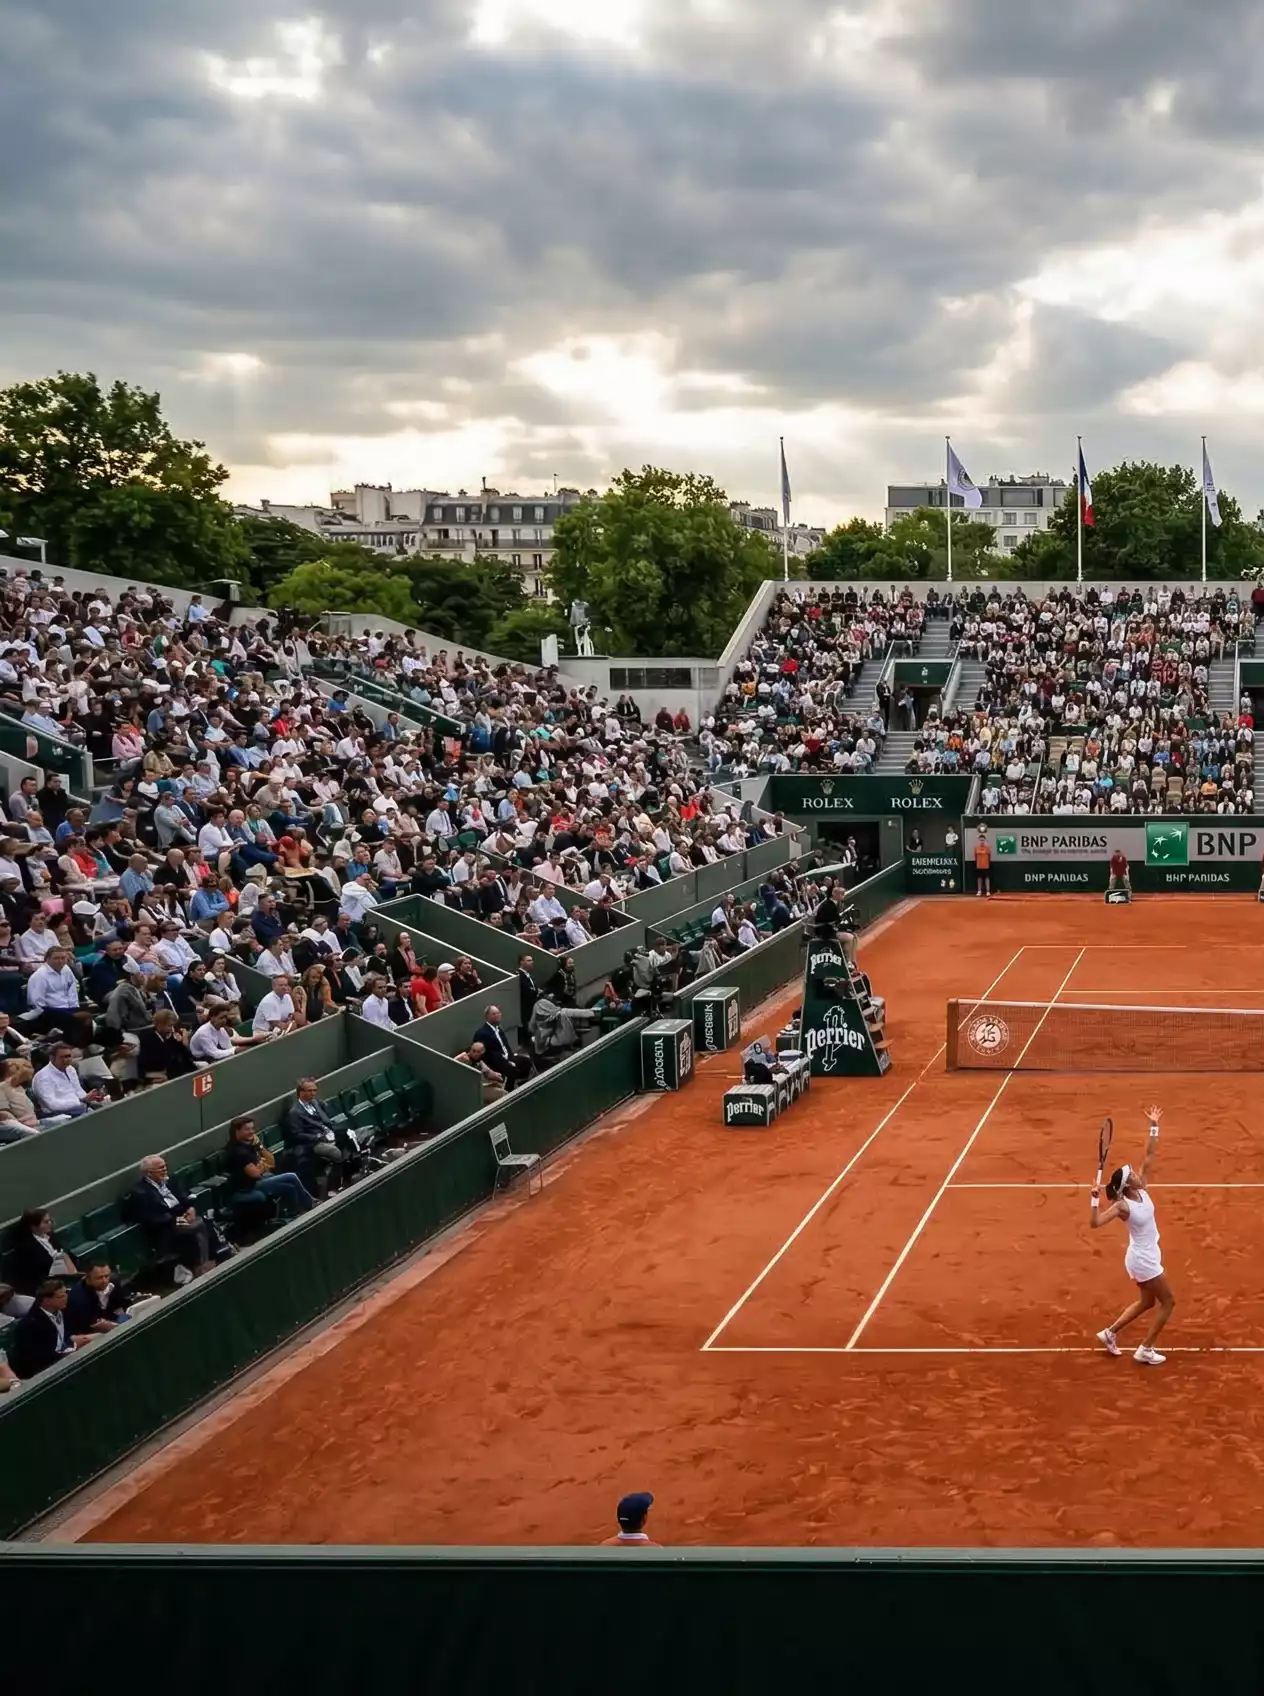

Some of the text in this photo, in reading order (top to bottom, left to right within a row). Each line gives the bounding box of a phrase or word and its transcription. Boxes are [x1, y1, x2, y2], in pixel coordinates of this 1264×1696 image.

[802, 797, 854, 809] ROLEX
[890, 797, 943, 809] ROLEX
[1021, 835, 1108, 848] BNP PARIBAS
[1196, 832, 1257, 856] BNP
[805, 1024, 865, 1059] perrier
[726, 1098, 765, 1123] perrier
